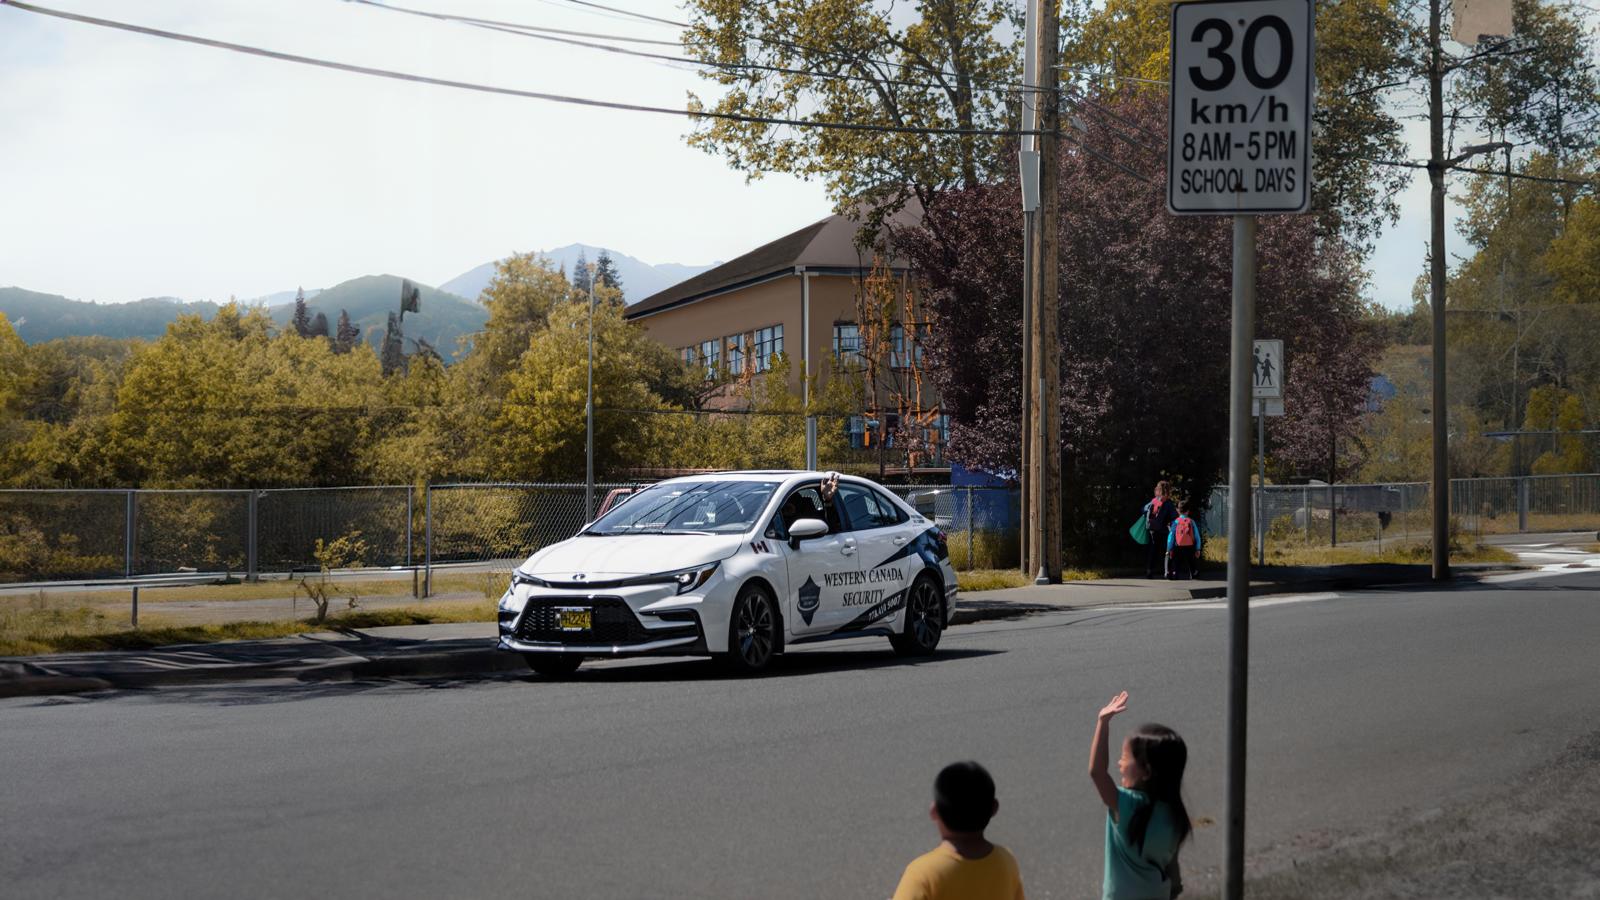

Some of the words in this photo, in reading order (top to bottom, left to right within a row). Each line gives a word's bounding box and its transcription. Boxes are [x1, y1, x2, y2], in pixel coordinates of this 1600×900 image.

[1188, 14, 1294, 92] 30
[1190, 95, 1288, 125] km/h
[1181, 168, 1248, 194] SCHOOL
[1255, 167, 1296, 193] DAYS
[824, 570, 867, 587] WESTERN
[868, 567, 904, 583] CANADA
[842, 588, 885, 607] SECURITY
